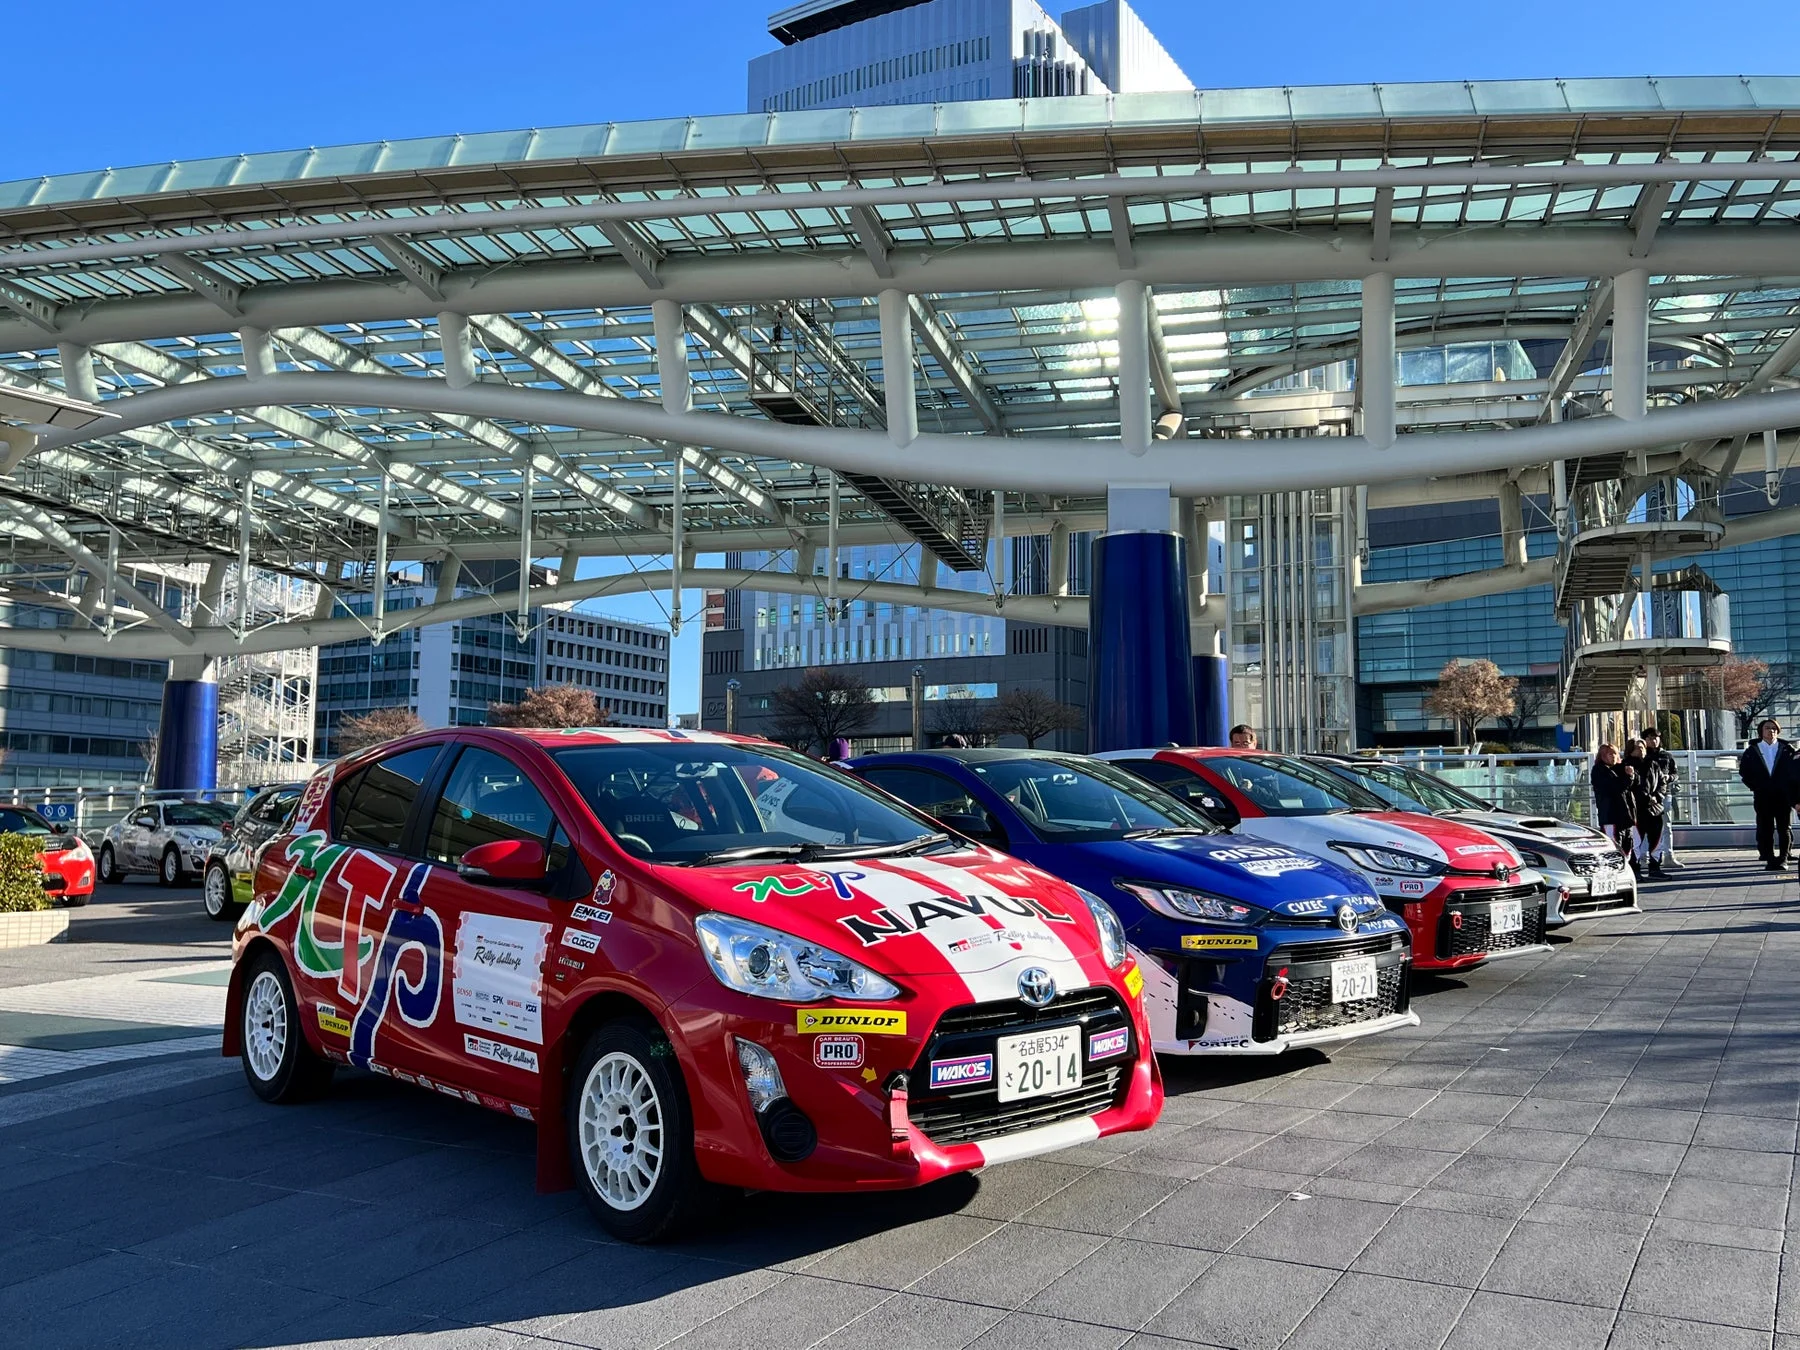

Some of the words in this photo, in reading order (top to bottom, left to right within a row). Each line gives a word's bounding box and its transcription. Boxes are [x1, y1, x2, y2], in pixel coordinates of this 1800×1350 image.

[624, 813, 665, 824] BRIDE
[1404, 883, 1420, 891] PRO
[575, 905, 611, 921] ENKEI
[1287, 900, 1328, 915] CVTEC
[841, 895, 1074, 946] NAVUL
[571, 936, 595, 950] CUSCO
[1196, 938, 1252, 947] DUNLOP
[456, 987, 473, 998] DENSO
[492, 994, 504, 1005] SPK
[325, 1019, 349, 1031] DUNLOP
[820, 1016, 899, 1027] DUNLOP
[823, 1044, 854, 1059] PRO
[1005, 1071, 1014, 1088] さ
[1018, 1052, 1078, 1094] 20-14
